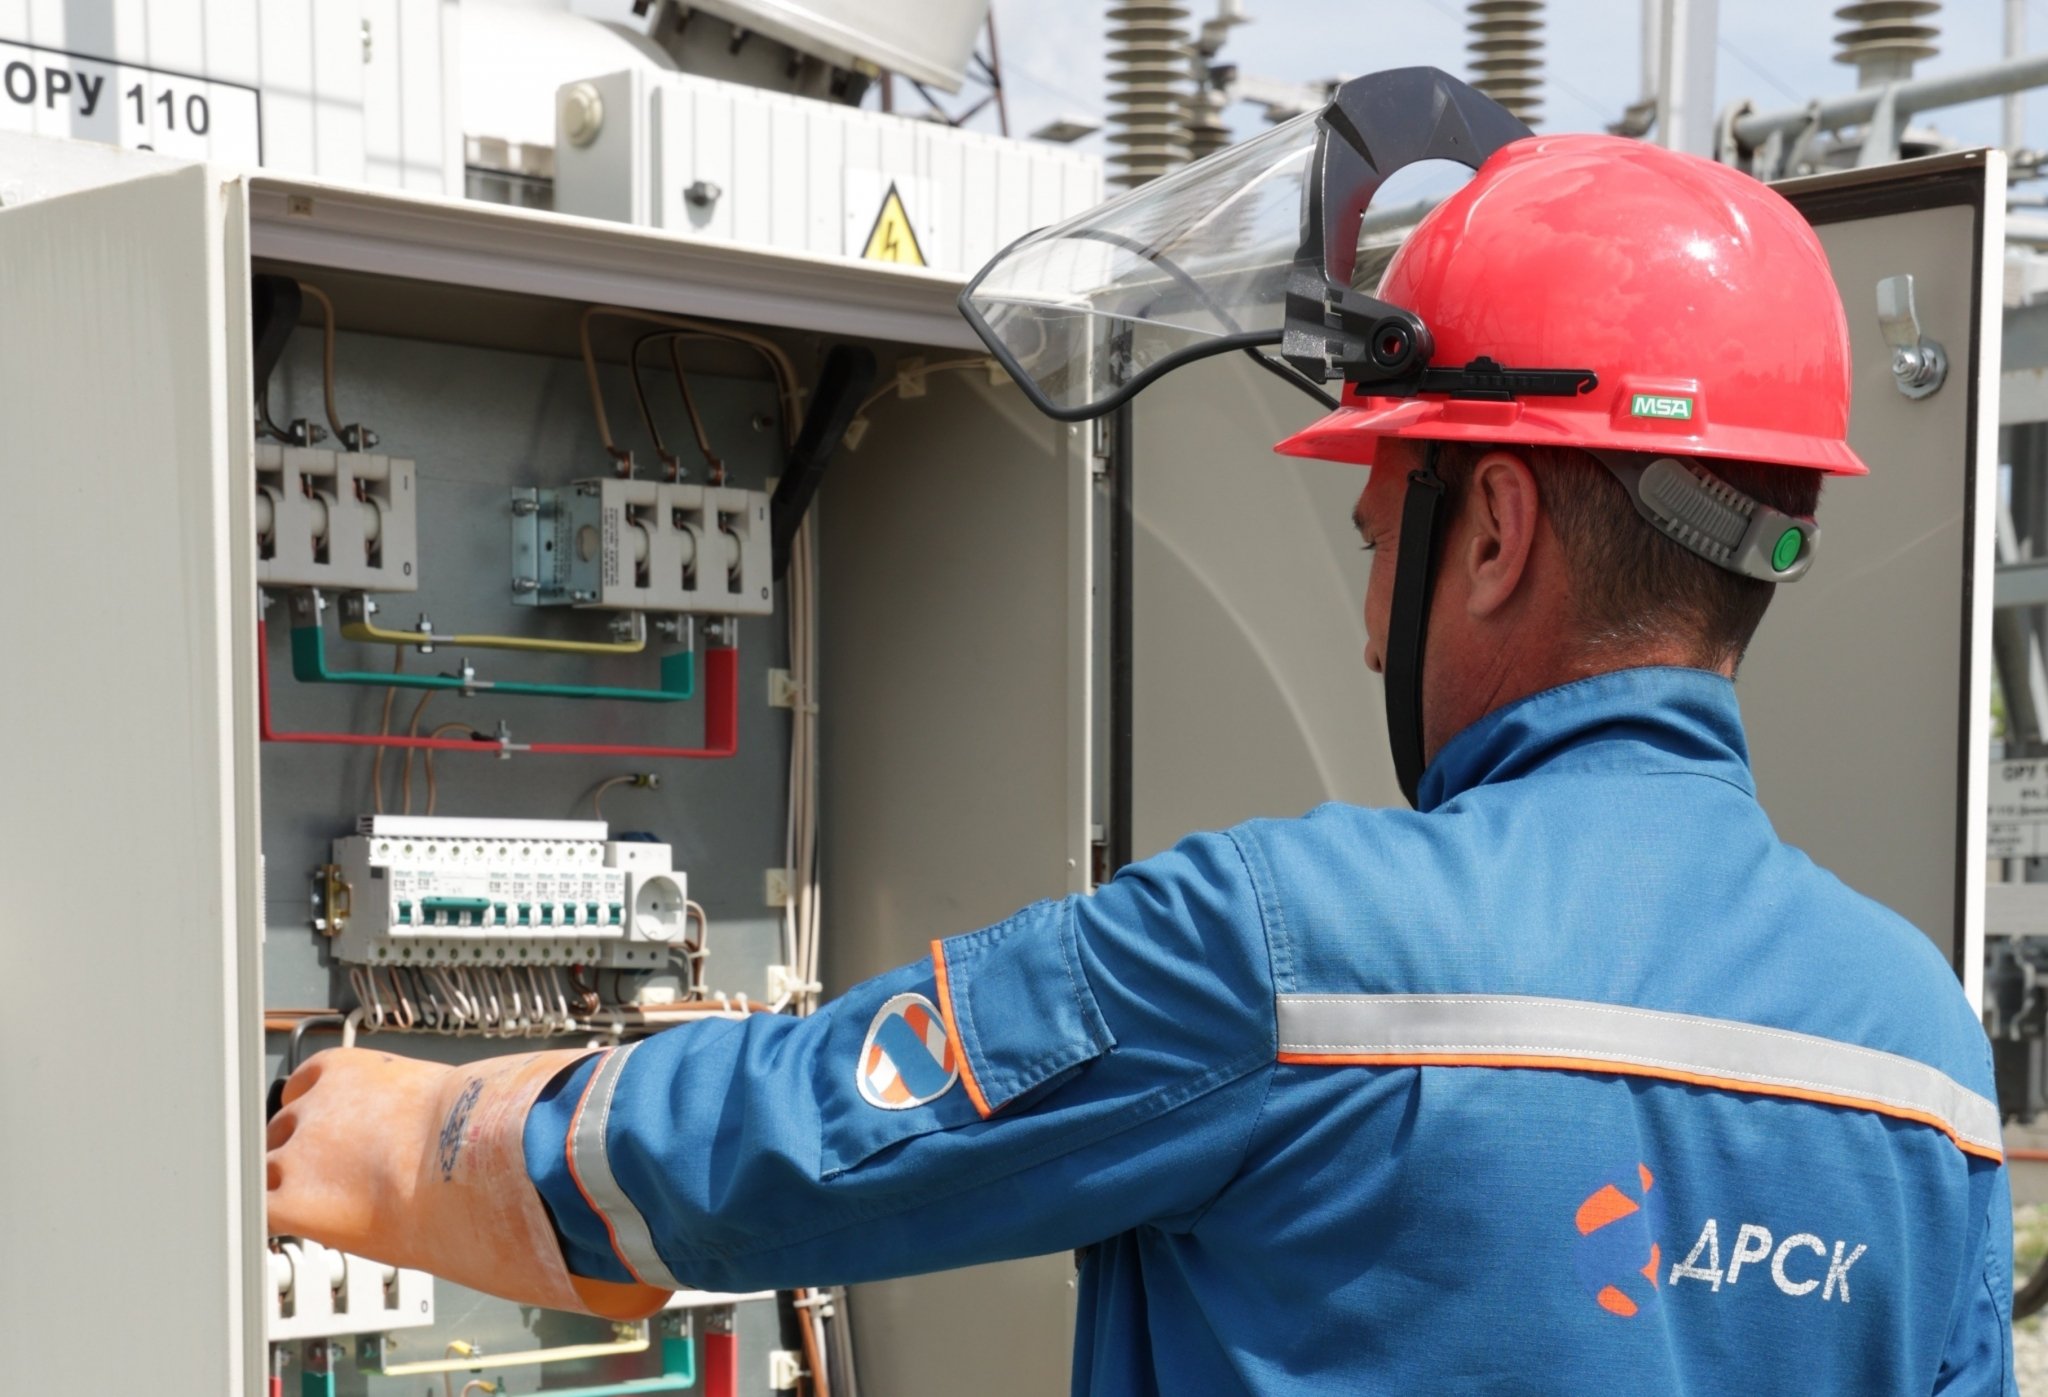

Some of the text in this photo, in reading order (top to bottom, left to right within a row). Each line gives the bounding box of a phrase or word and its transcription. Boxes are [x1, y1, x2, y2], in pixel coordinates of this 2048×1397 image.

[126, 83, 210, 135] 110
[1634, 397, 1689, 417] MSA
[1669, 1218, 1868, 1304] ДРСК
